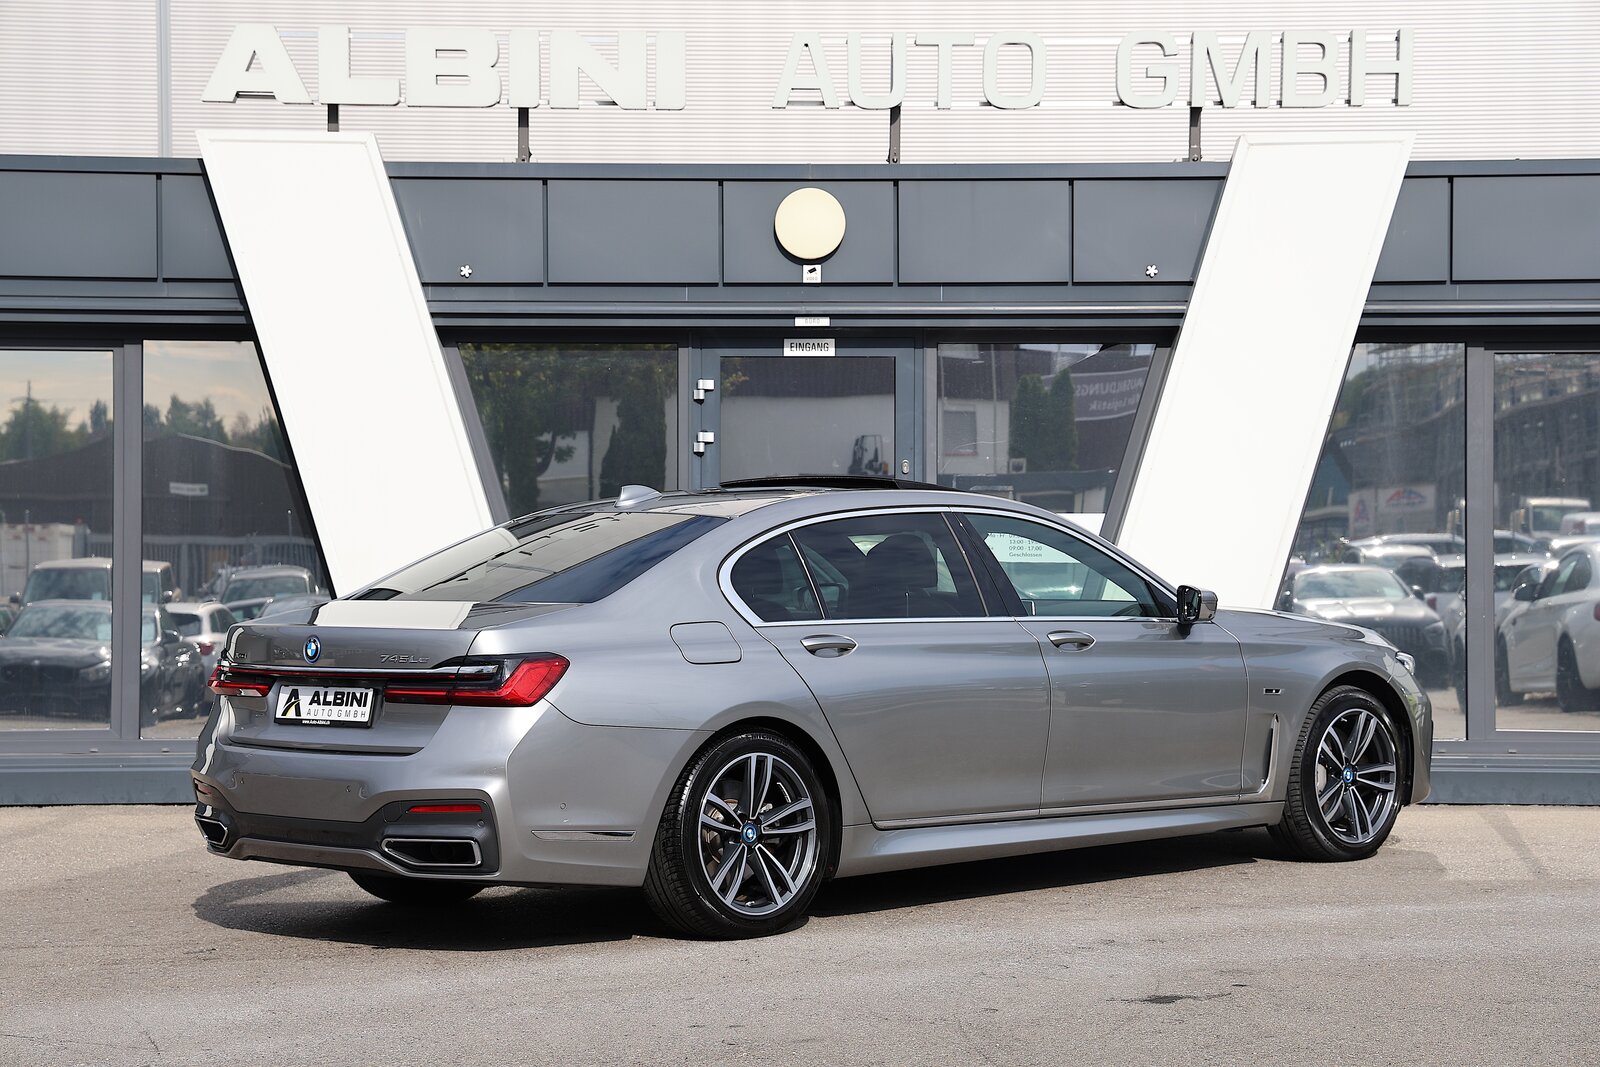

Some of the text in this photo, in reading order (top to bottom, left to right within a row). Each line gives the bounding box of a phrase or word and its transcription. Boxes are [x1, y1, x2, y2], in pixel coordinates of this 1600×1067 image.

[200, 24, 1414, 110] ALBINI AUTO GMBH
[789, 342, 829, 352] EINGANG
[308, 690, 369, 708] ALBINI
[306, 708, 367, 719] AUTO GMBH
